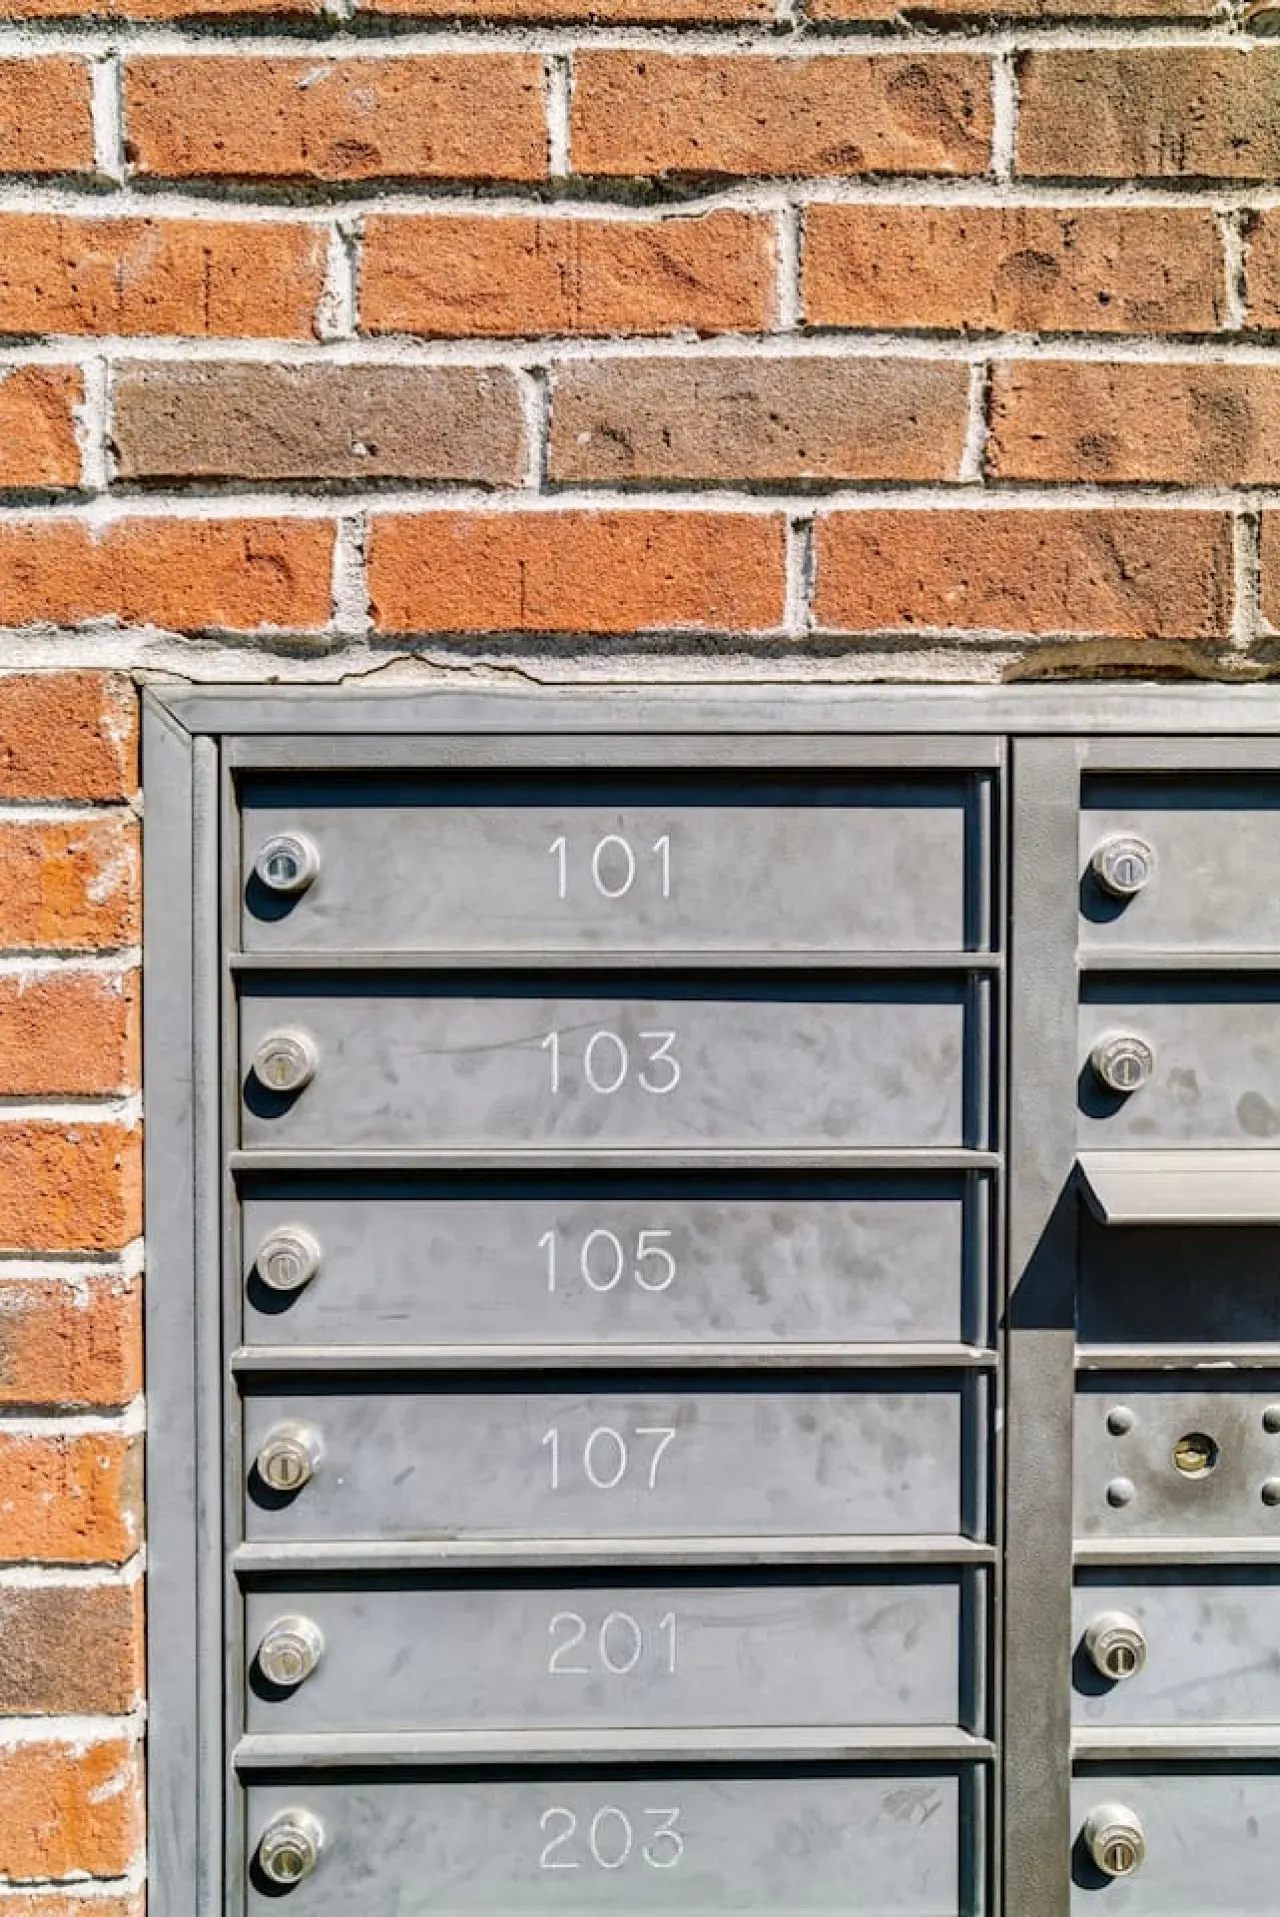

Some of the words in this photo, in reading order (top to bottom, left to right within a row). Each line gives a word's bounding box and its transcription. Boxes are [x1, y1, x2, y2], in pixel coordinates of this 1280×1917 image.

[549, 834, 671, 899] 101
[542, 1030, 682, 1094] 103
[537, 1229, 676, 1293] 105
[541, 1427, 676, 1489] 107
[548, 1612, 676, 1674] 201
[540, 1806, 684, 1868] 203
